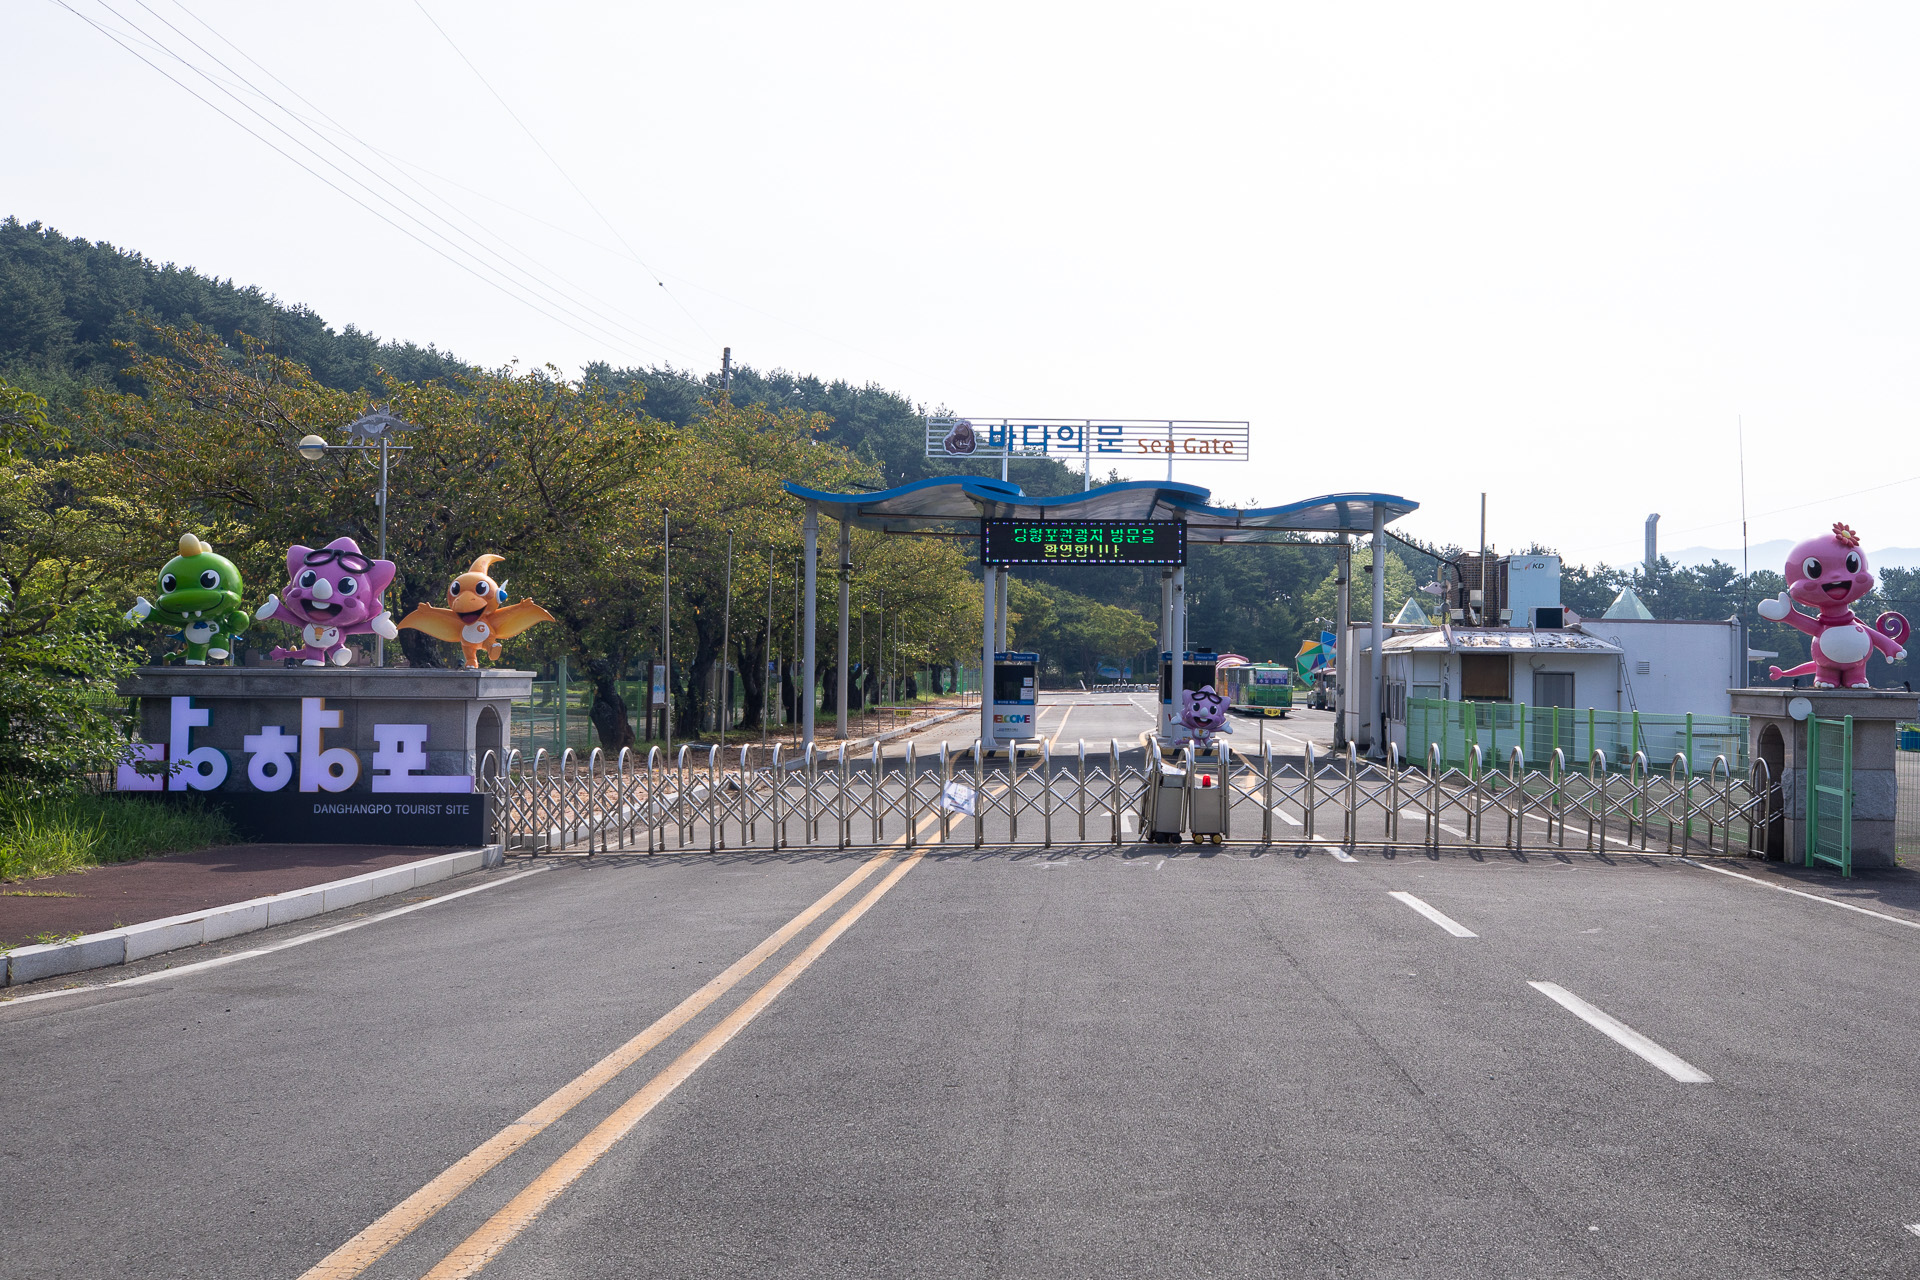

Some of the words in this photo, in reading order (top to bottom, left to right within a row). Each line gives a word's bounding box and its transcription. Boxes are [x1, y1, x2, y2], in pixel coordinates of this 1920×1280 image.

[988, 424, 1083, 453] 바다의
[1097, 425, 1123, 453] 문
[1137, 438, 1175, 454] Sea
[1184, 437, 1234, 454] Gate
[1111, 528, 1154, 543] 방문을
[329, 629, 336, 637] J
[477, 624, 485, 633] G
[994, 714, 1031, 723] ELCOME
[117, 697, 475, 793] 당항포
[313, 804, 392, 814] DANGHANGPO
[395, 804, 443, 814] TOURIST
[445, 804, 470, 815] SITE
